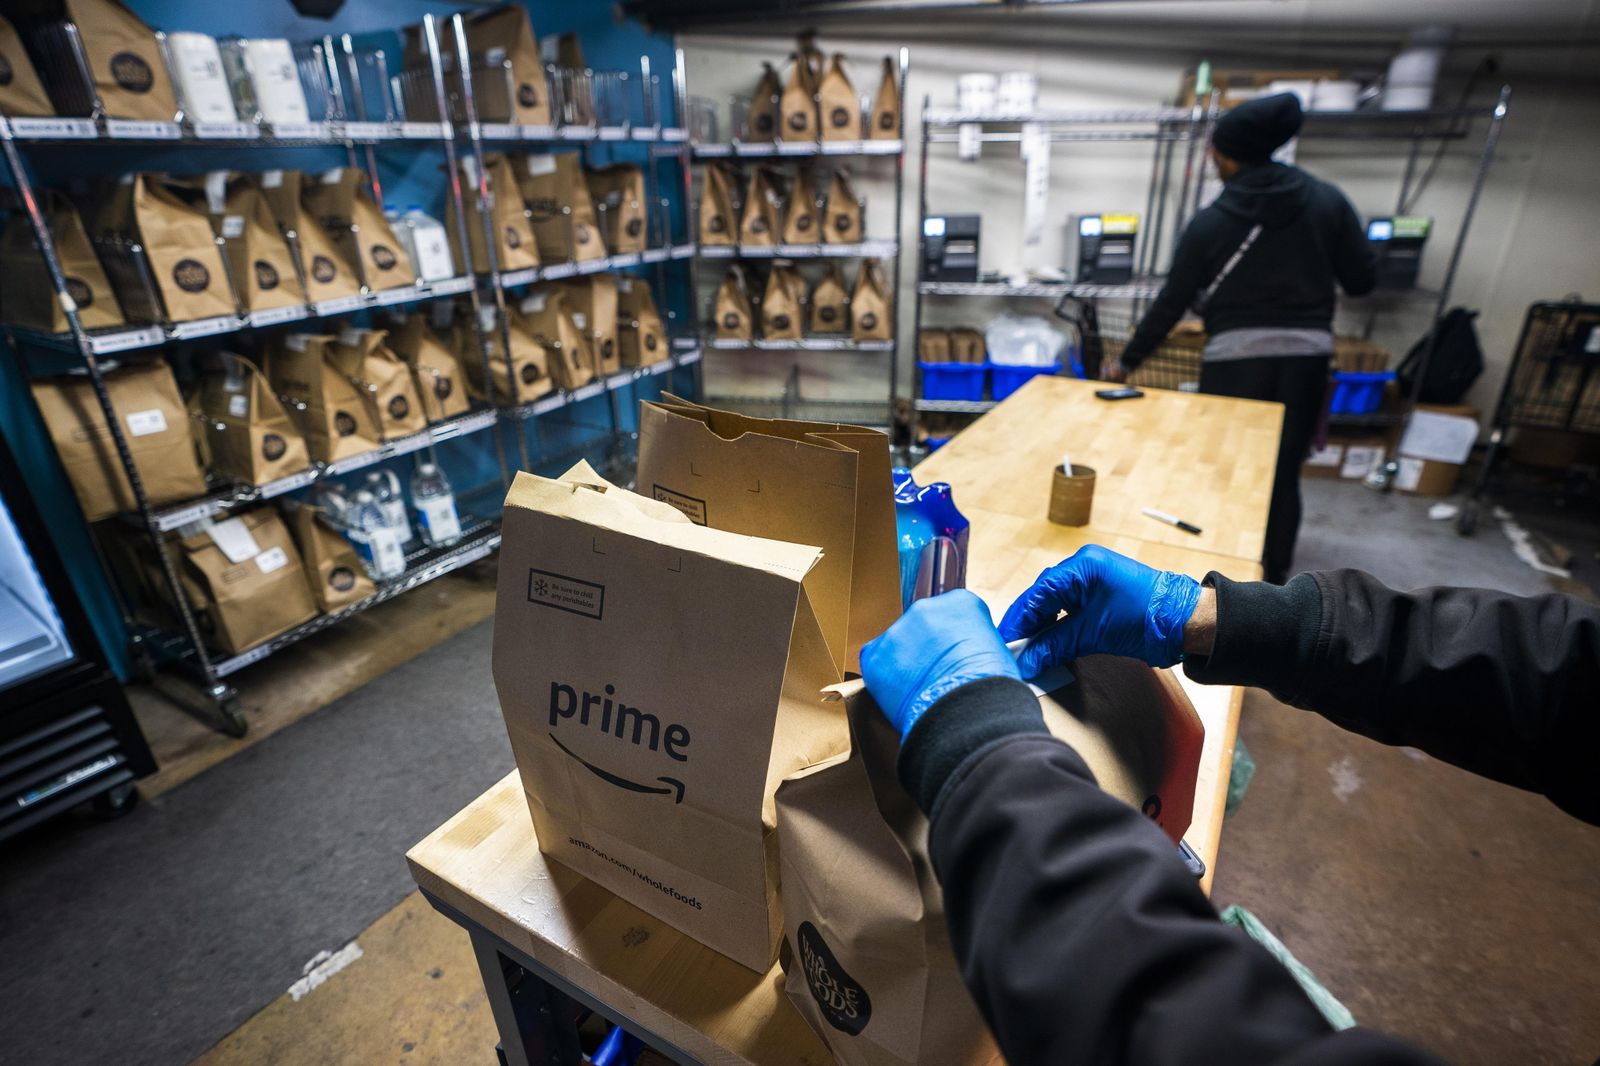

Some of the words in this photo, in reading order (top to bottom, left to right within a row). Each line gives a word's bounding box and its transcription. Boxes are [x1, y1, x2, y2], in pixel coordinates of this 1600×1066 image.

[551, 592, 562, 600] any
[562, 596, 594, 608] perishables
[580, 591, 593, 599] chill
[548, 681, 691, 762] prime
[568, 836, 703, 911] amazon.com/wholefoods
